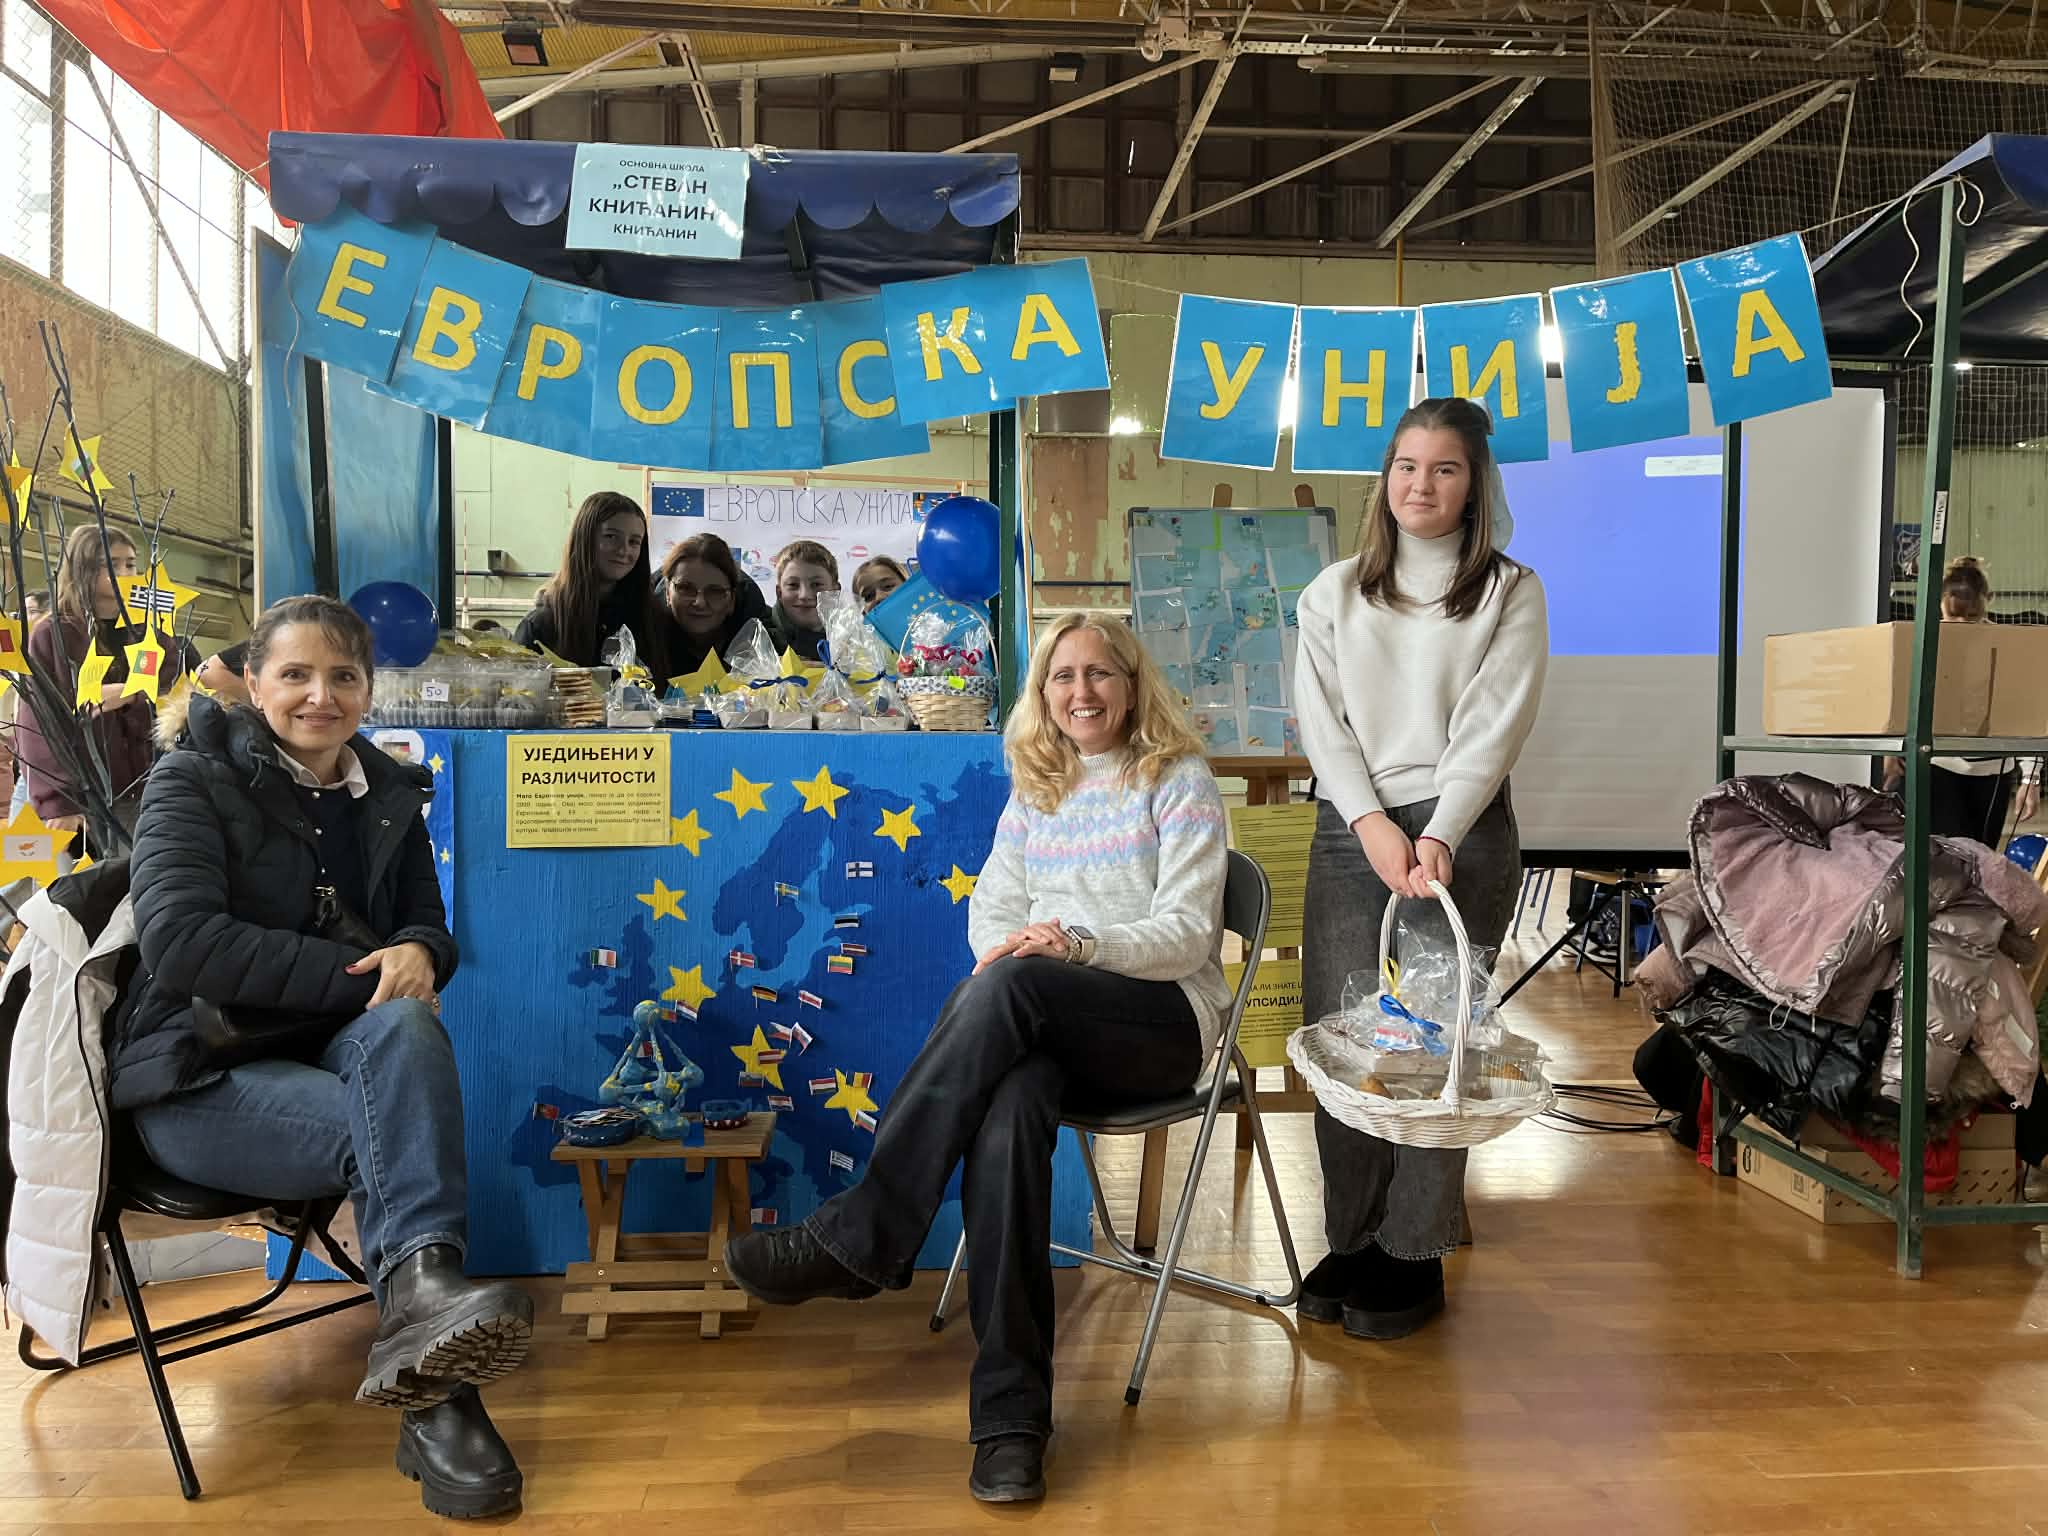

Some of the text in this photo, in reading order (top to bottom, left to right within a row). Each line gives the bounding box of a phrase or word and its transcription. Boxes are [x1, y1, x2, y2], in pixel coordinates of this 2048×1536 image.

[619, 159, 705, 173] ОСНОВНА ШКОЛА
[613, 223, 697, 240] КНИЋАНИН
[316, 242, 1806, 430] ЕВРОПСКА УНИЈА
[708, 487, 914, 525] ЕВРОПСКА УНИЈА
[523, 746, 655, 764] УЈЕДИЊЕНИ У
[521, 770, 656, 785] РАЗЛИЧИТОСТИ
